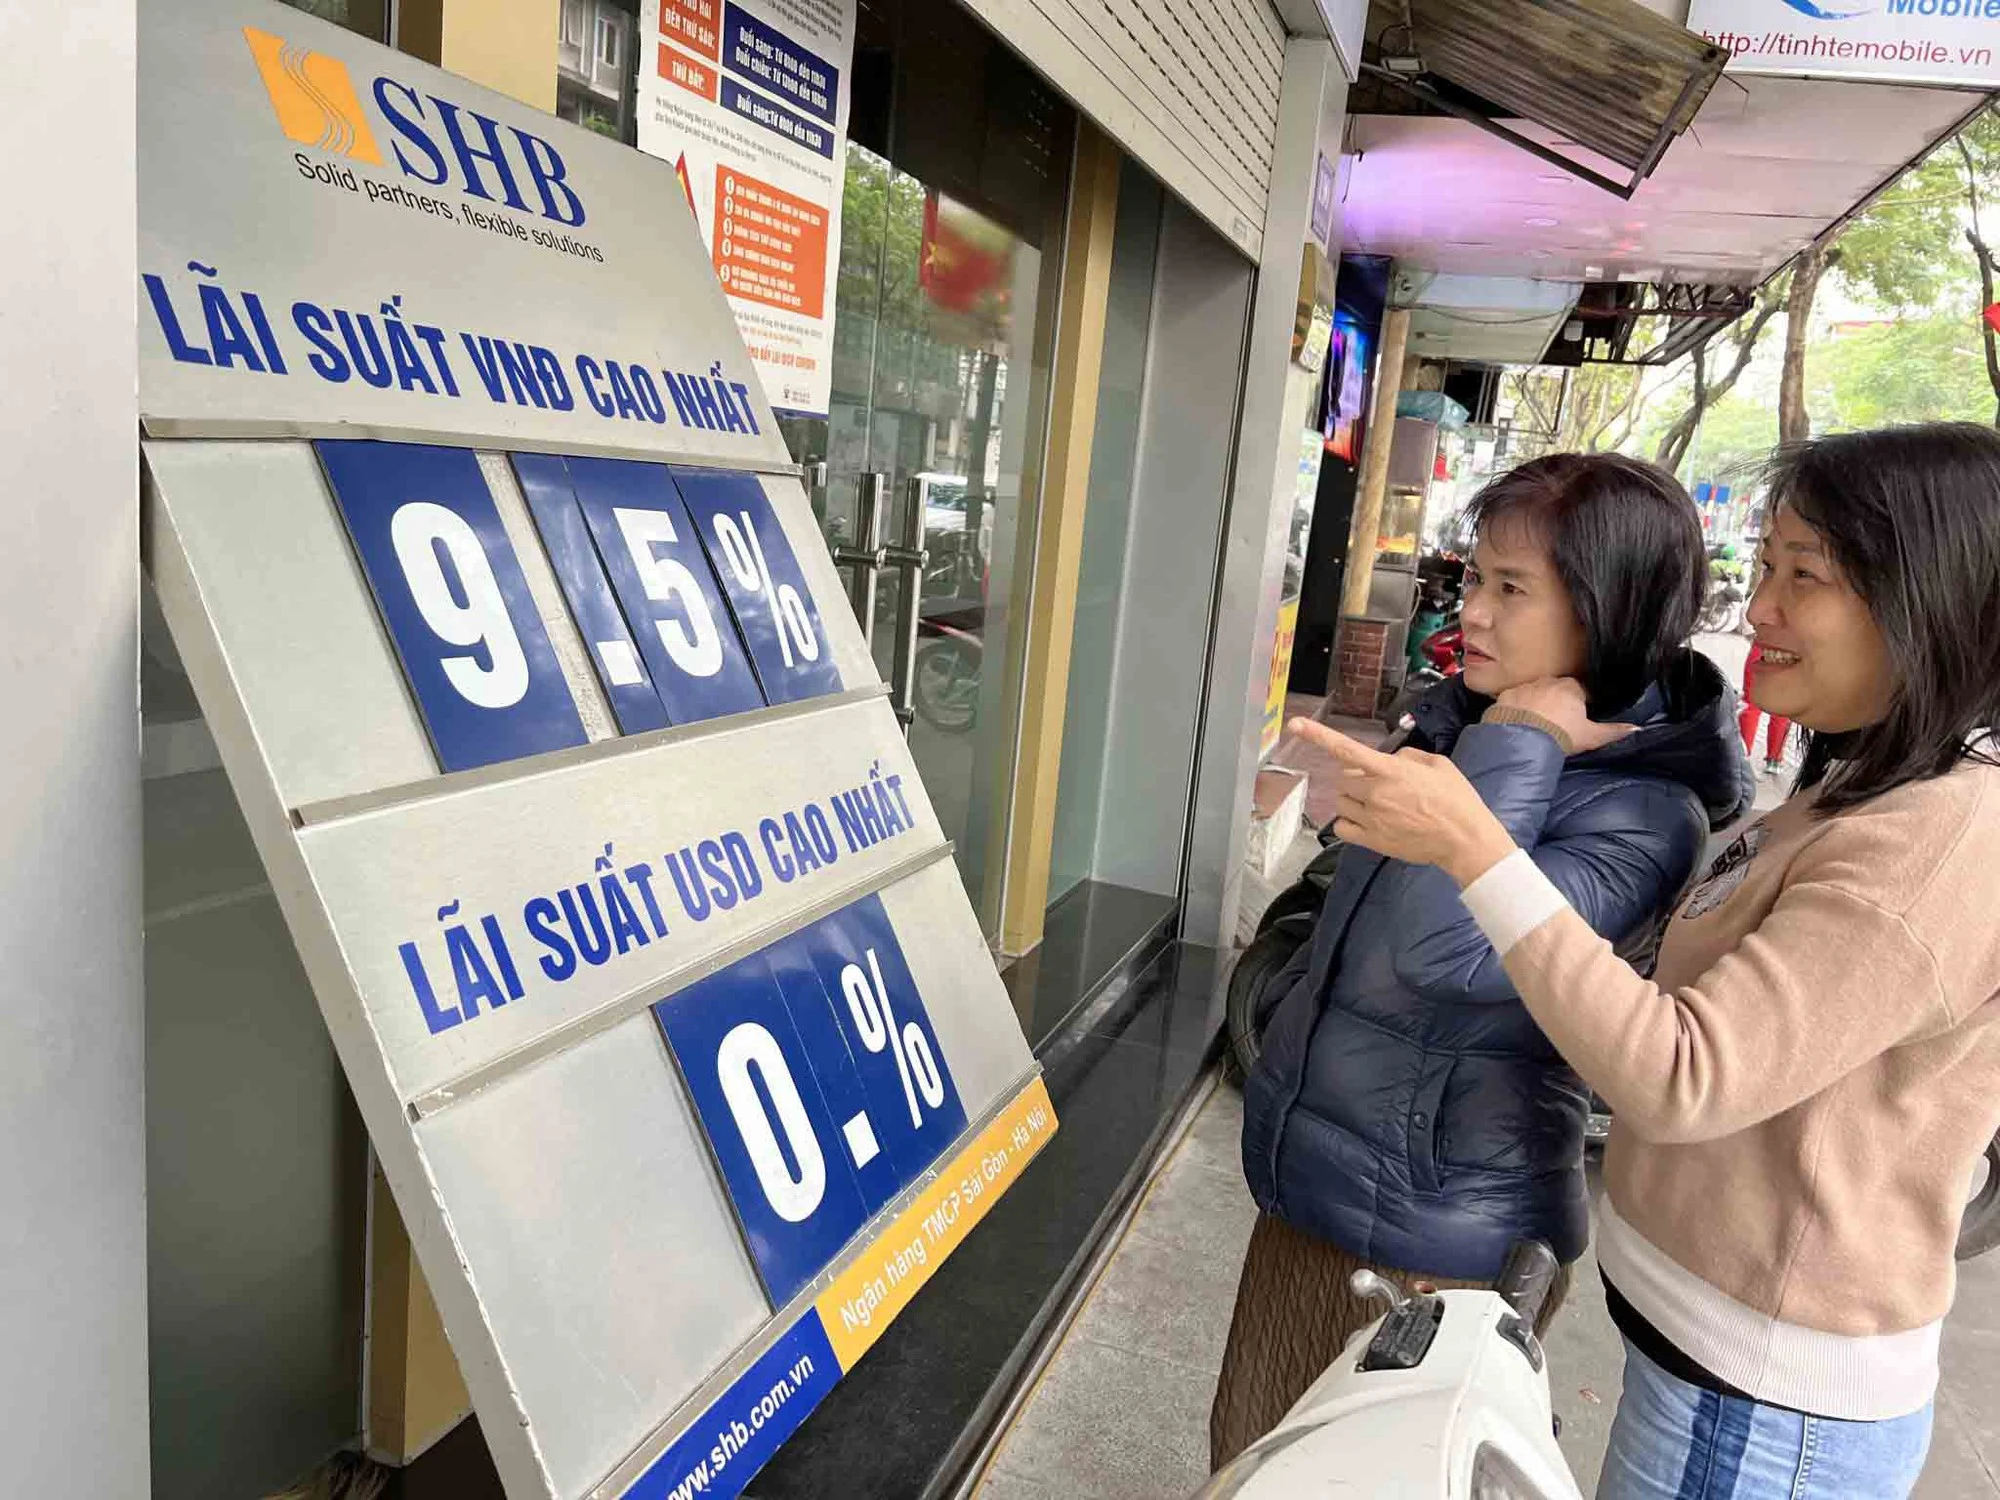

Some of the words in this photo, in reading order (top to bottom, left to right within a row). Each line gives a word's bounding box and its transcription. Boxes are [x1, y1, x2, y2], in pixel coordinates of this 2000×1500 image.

[1702, 30, 1992, 65] http://tinhtemobile.vn
[1886, 0, 2000, 18] Mobile
[294, 152, 358, 193] Solid
[363, 178, 462, 226] partners,
[461, 202, 529, 242] flexible
[531, 227, 604, 263] solutions
[372, 76, 586, 228] SHB
[141, 260, 289, 376] LÃI
[291, 295, 461, 398] SUẤT
[459, 332, 576, 412] VNĐ
[575, 353, 667, 425] CAO
[663, 359, 761, 436] NHẤT
[398, 898, 526, 1036] LÃI
[523, 842, 671, 982] SUẤT
[664, 830, 764, 922] USD
[758, 803, 839, 884] CAO
[829, 760, 916, 855] NHẤT
[839, 1276, 889, 1333] Ngân
[884, 1237, 928, 1286] hàng
[921, 1190, 962, 1245] TMCP
[960, 1169, 985, 1205] Sài
[981, 1148, 1010, 1183] Gòn
[1011, 1123, 1031, 1151] Hà
[1026, 1103, 1048, 1133] Nội
[667, 1353, 816, 1500] ww.shb.com.vn
